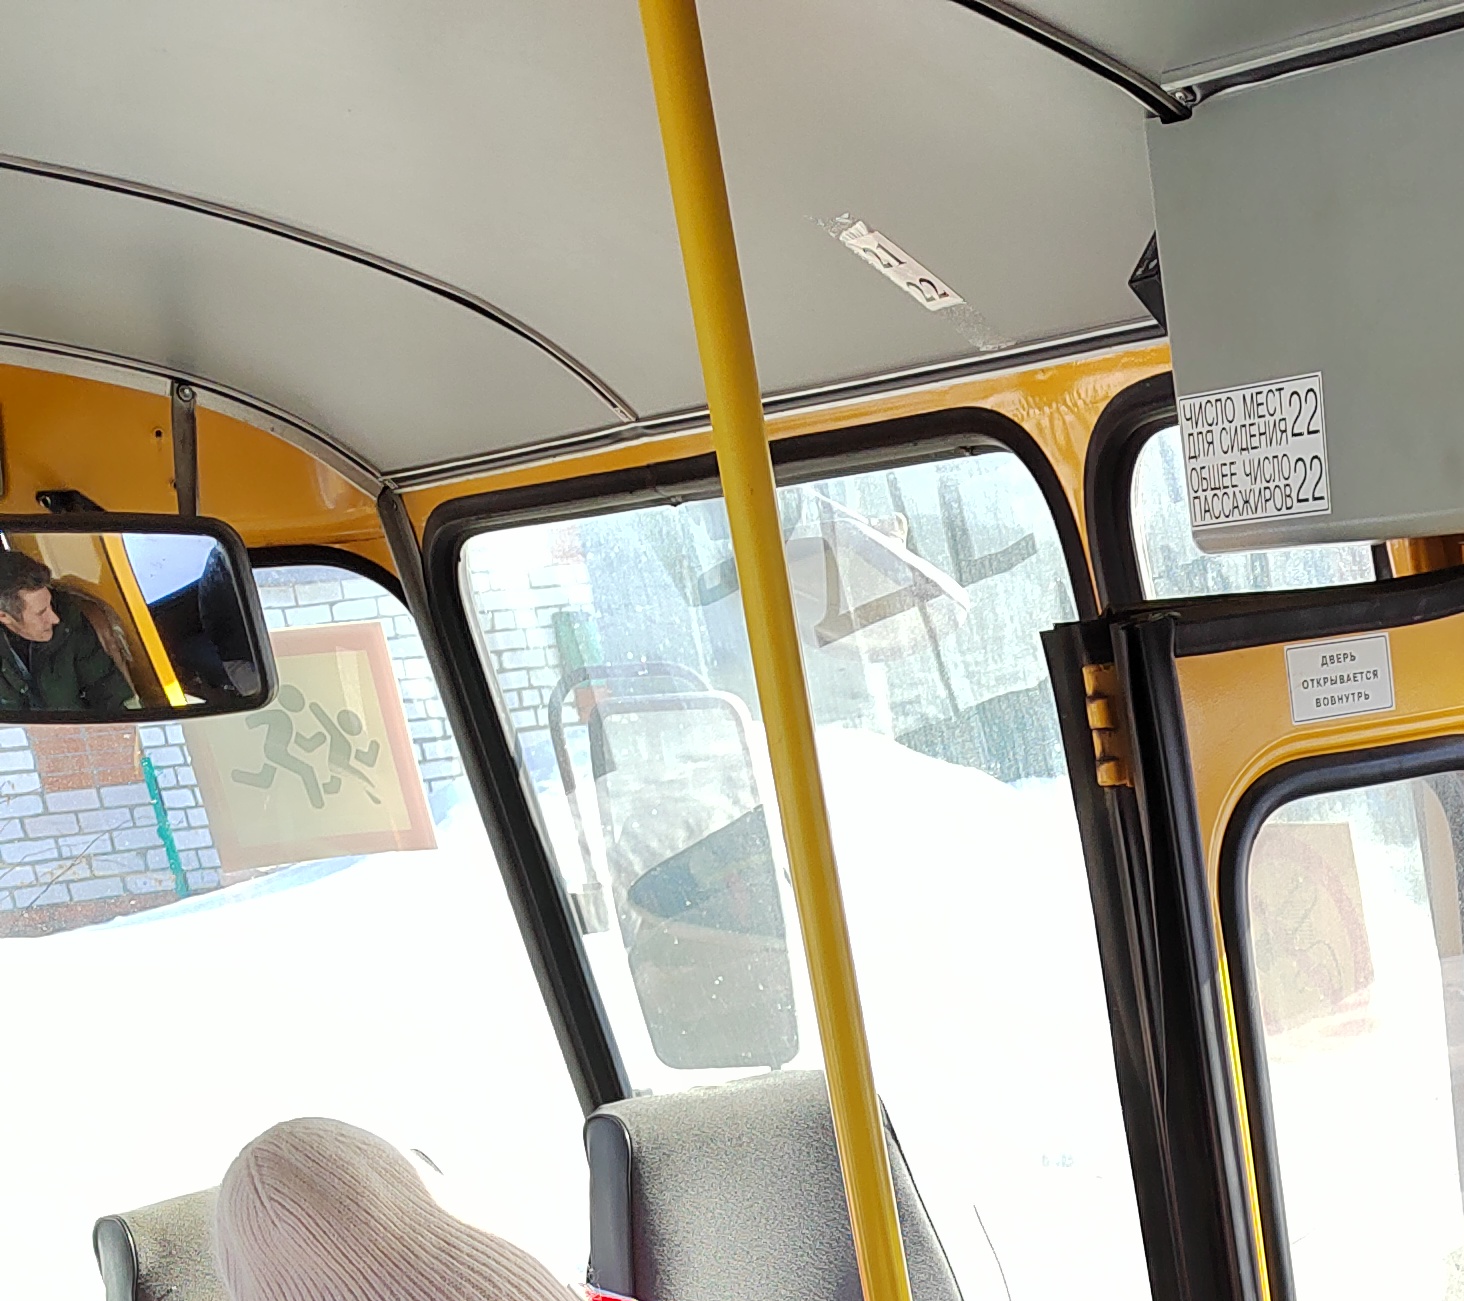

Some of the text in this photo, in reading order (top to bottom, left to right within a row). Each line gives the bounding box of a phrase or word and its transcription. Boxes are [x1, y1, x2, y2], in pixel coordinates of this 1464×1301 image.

[862, 243, 907, 268] 21
[905, 277, 950, 303] 22
[1183, 387, 1285, 430] ЧИСЛО МЕСТ
[1288, 388, 1320, 438] 22
[1188, 417, 1289, 462] ДЛЯ СИДЕНИЯ
[1190, 453, 1291, 493] ОБЩЕЕ ЧИСЛО
[1294, 455, 1325, 503] 22
[1192, 483, 1294, 522] ПАССАЖИРОВ
[1301, 669, 1379, 690] ОТКРЫВАЕТСЯ
[1320, 652, 1356, 668] ДВЕРЬ
[1315, 690, 1370, 708] ВОВНУТРЬ
